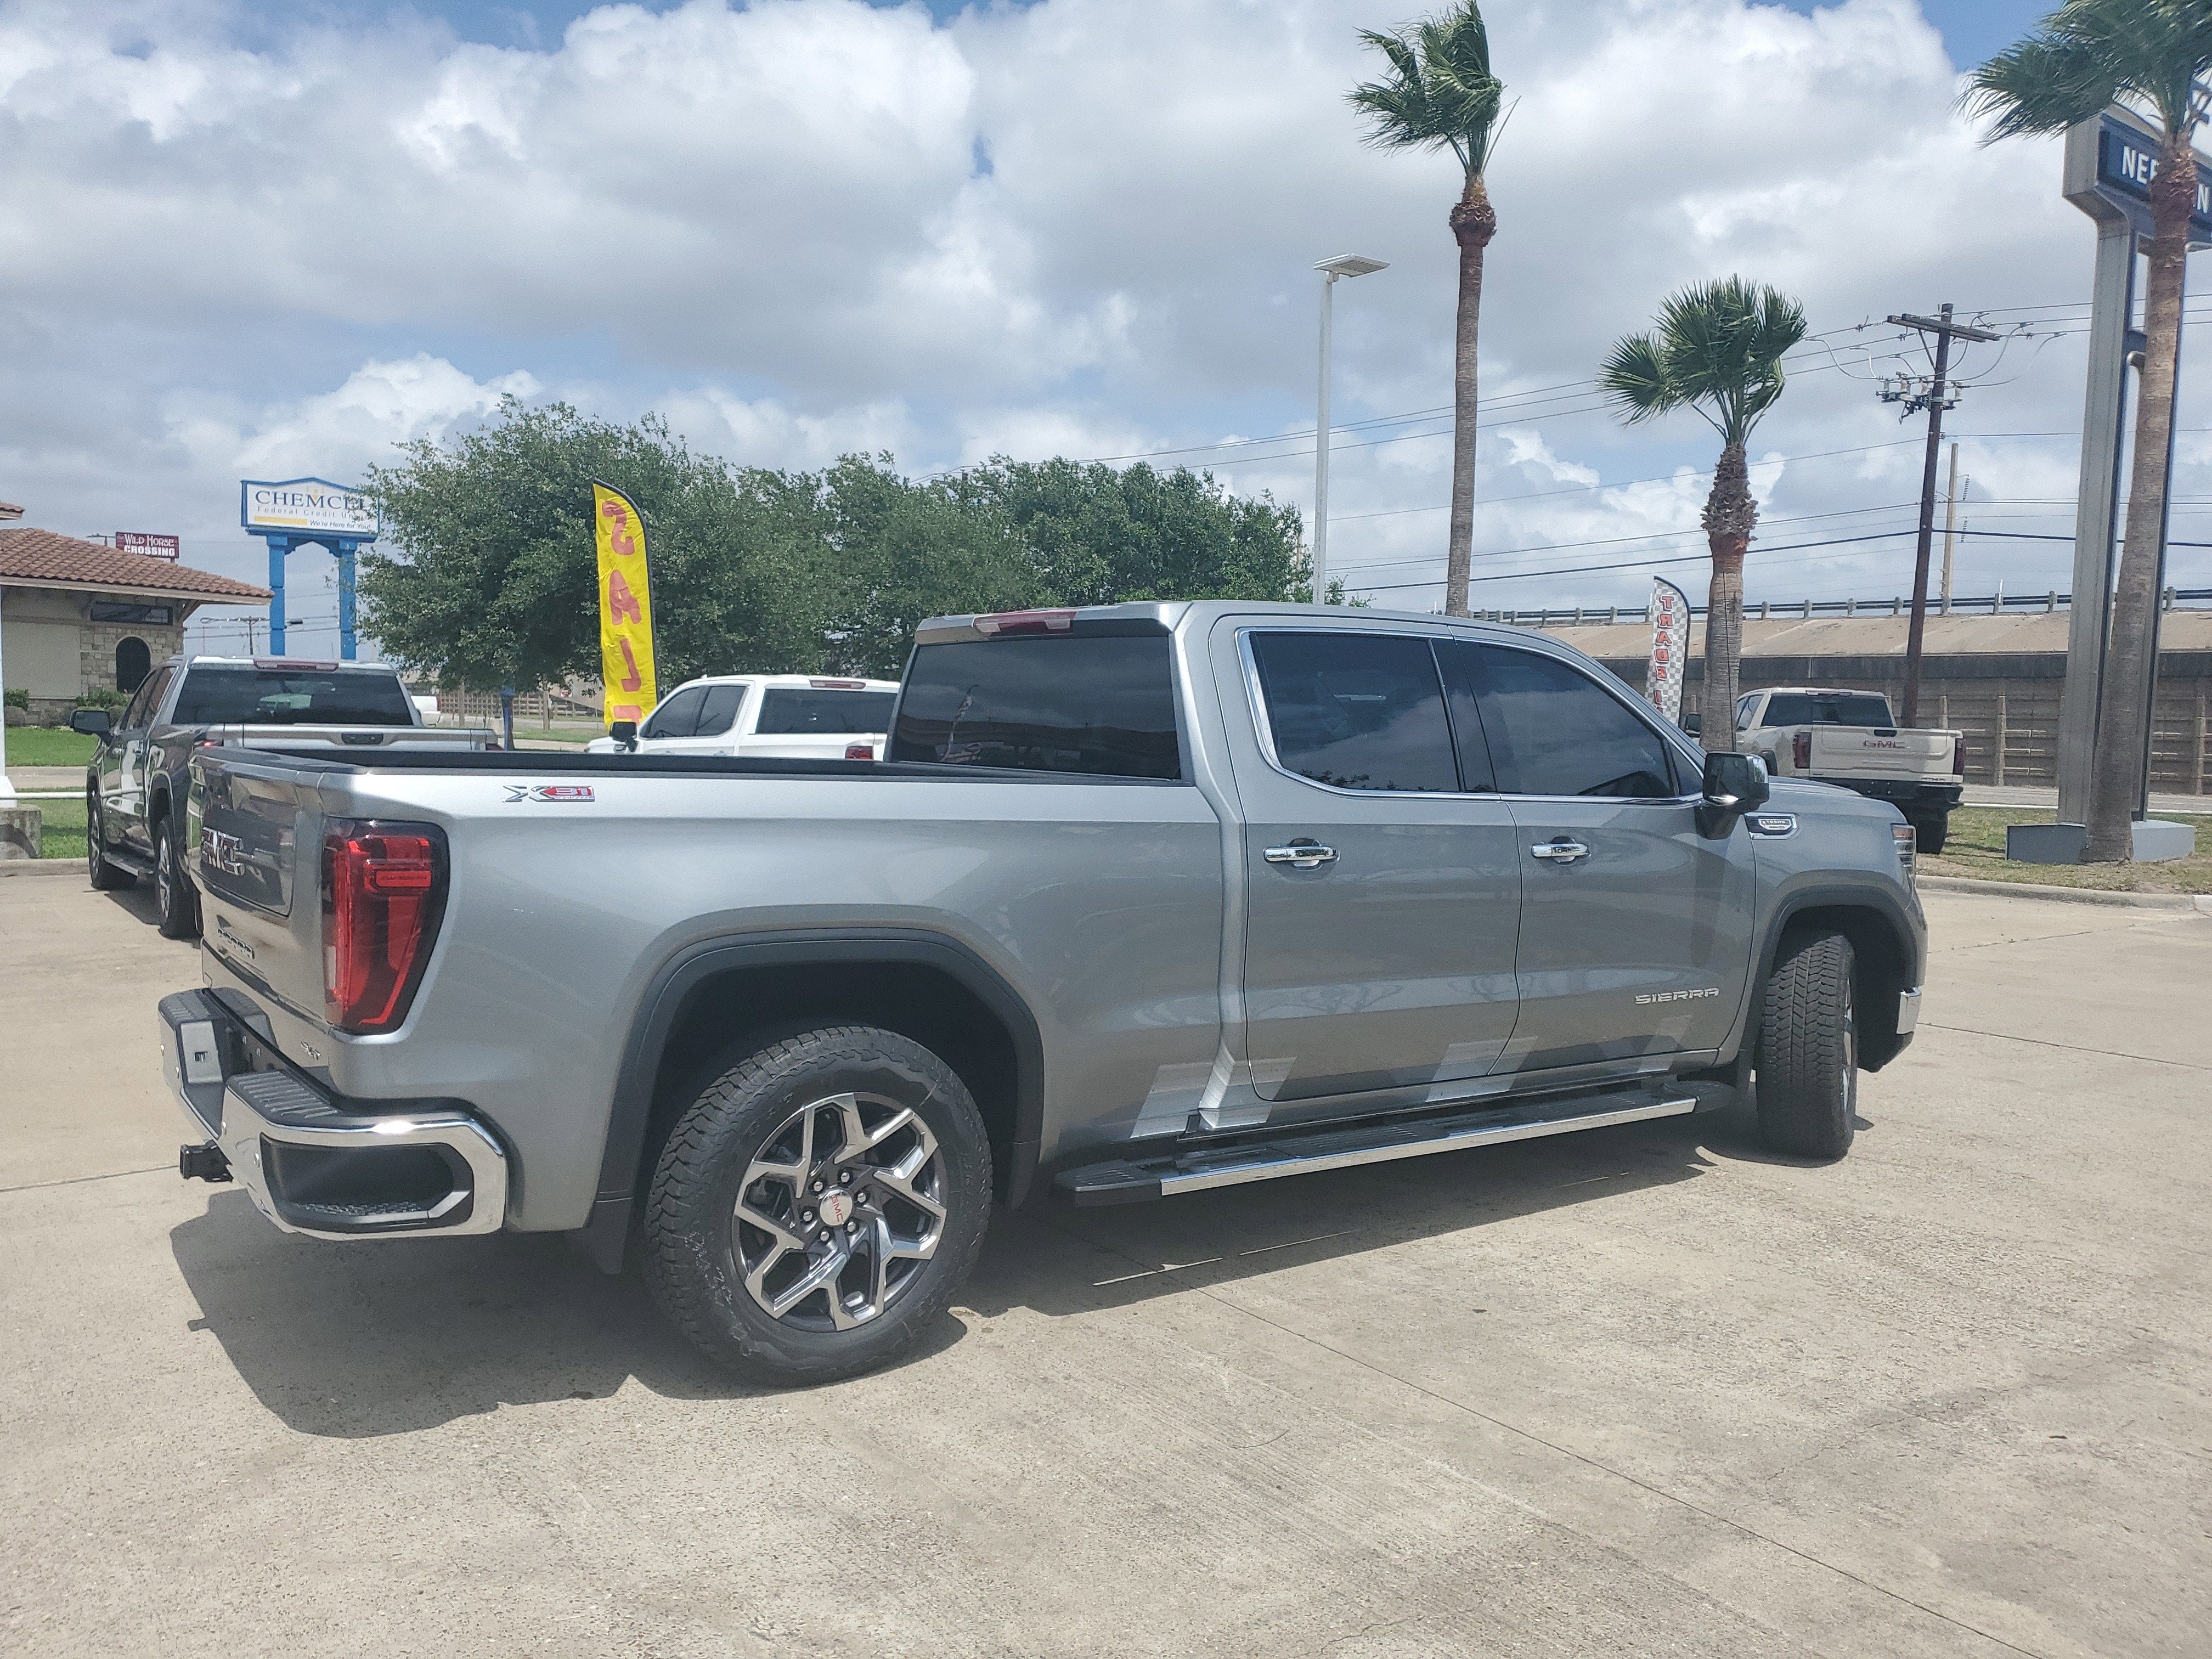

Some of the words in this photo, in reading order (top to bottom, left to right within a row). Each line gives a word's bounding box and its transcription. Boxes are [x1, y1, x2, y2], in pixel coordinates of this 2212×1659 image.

[255, 490, 371, 510] CHEMCL
[124, 533, 145, 545] WILD
[146, 535, 174, 547] HORSE
[123, 545, 175, 557] CROSSING
[1864, 740, 1905, 749] GMC
[1635, 988, 1719, 1005] SIERRA
[830, 1193, 844, 1222] GMC
